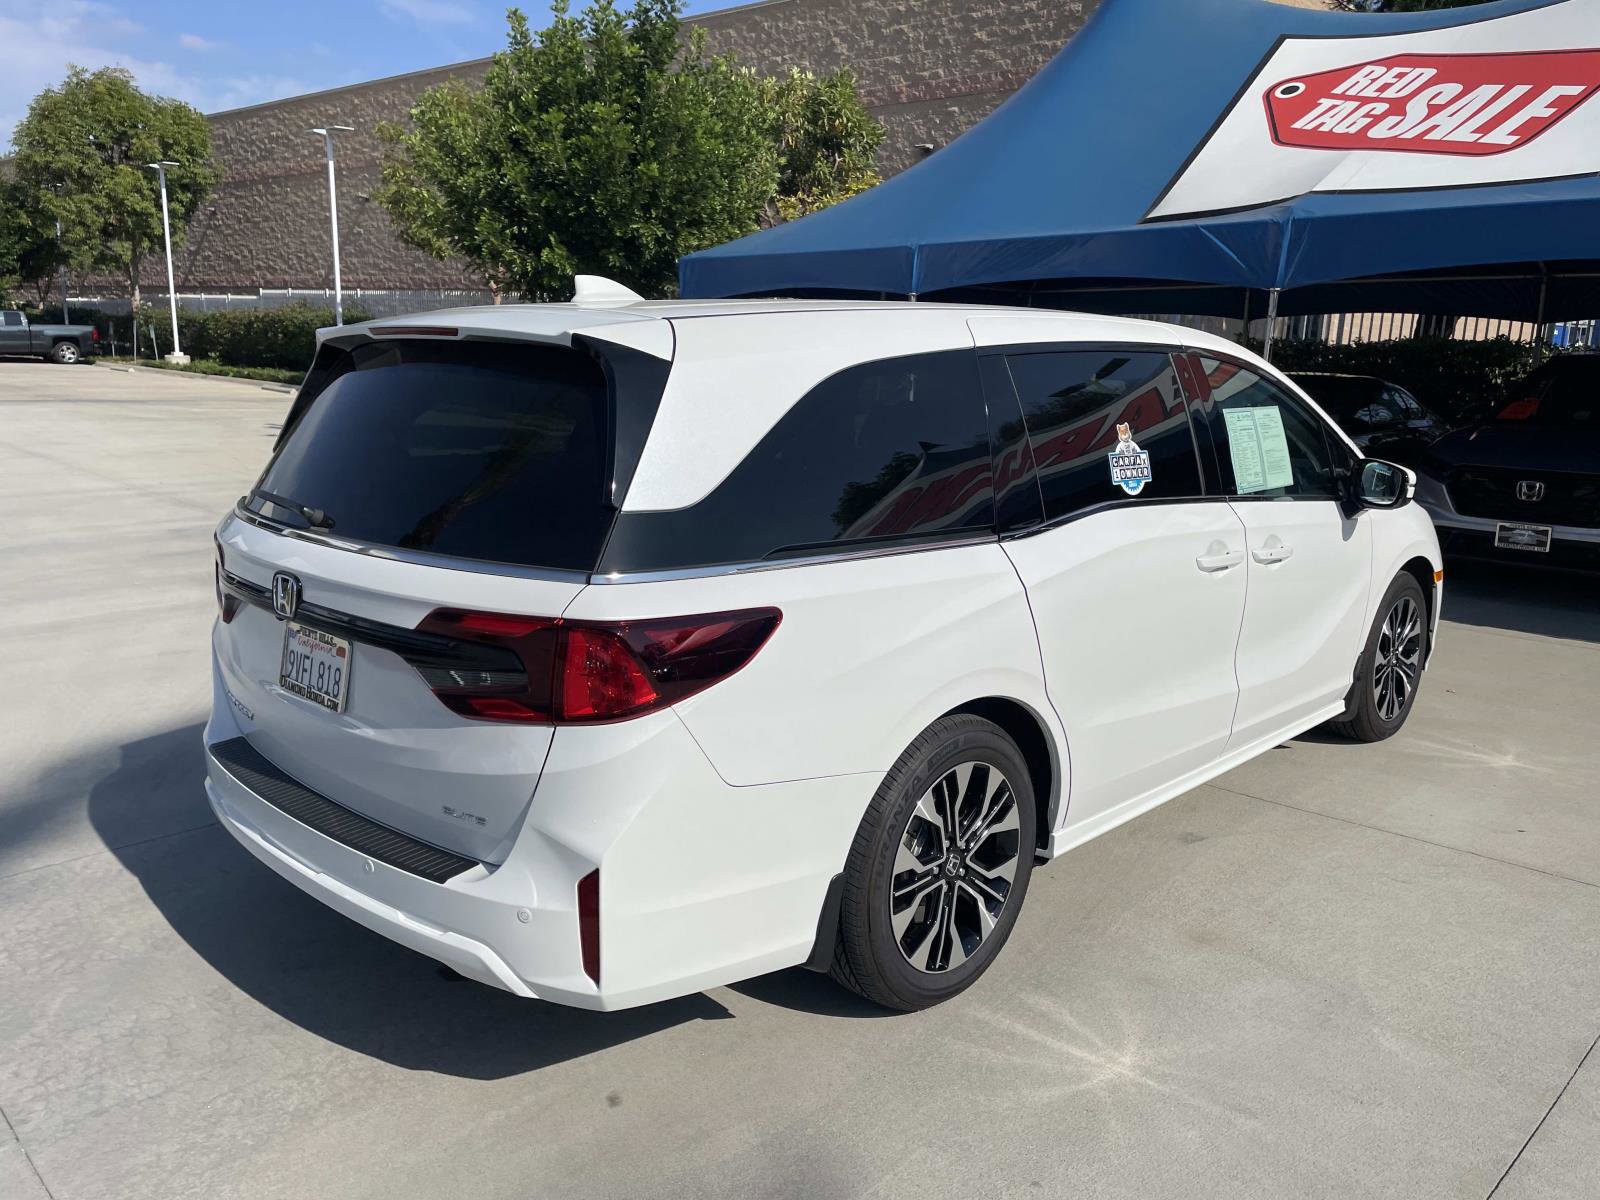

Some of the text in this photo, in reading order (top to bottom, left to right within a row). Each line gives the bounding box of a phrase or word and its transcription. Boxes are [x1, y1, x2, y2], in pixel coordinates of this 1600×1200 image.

[1331, 65, 1437, 98] RED
[1290, 98, 1390, 134] TAG
[1367, 82, 1587, 145] SALE
[1112, 455, 1148, 467] CARFAX
[288, 649, 341, 699] 9VFL818
